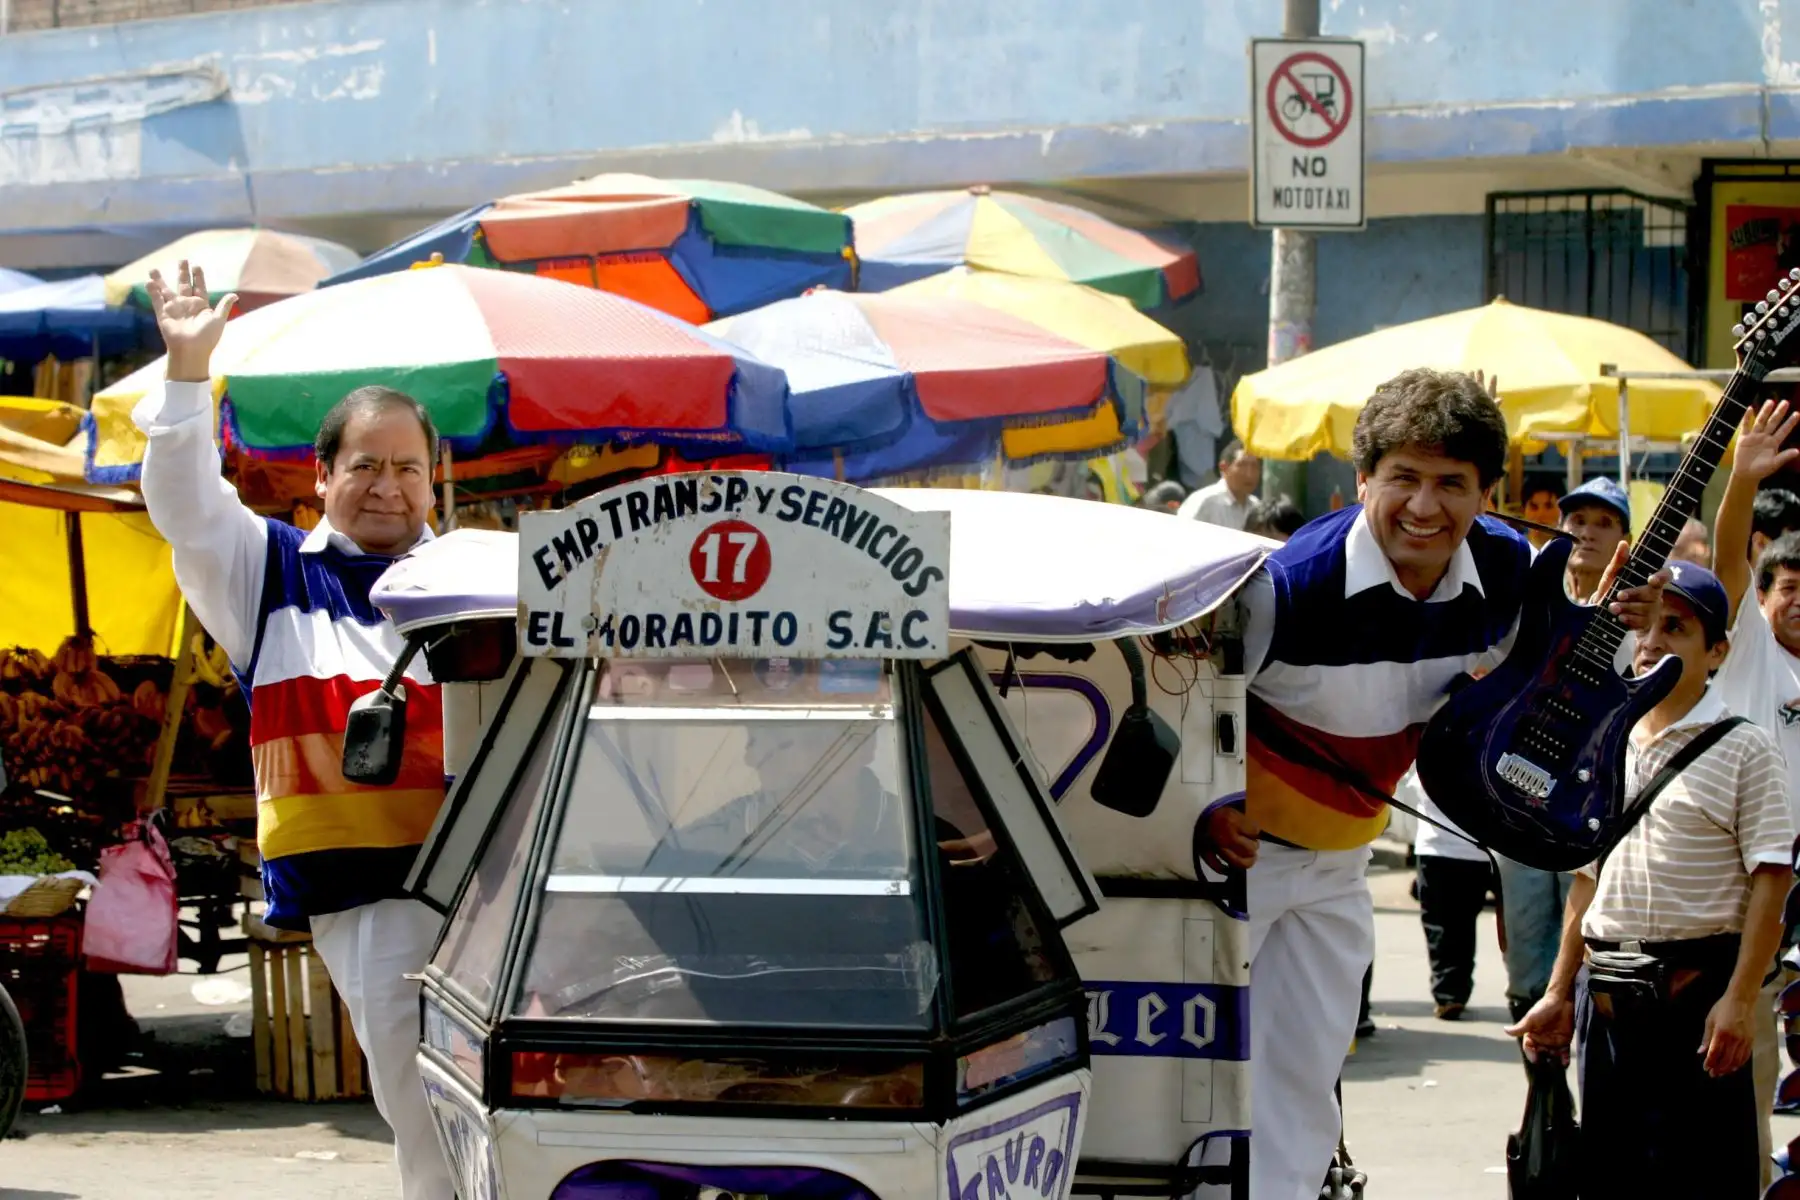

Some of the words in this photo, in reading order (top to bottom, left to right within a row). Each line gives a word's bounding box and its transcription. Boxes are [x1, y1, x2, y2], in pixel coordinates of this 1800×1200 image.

[1292, 156, 1327, 178] NO
[1272, 186, 1351, 210] MOTOTAXI
[532, 517, 604, 592] EMP.
[776, 484, 945, 598] SERVICIOS
[698, 531, 760, 584] 17
[526, 610, 575, 648] EL
[825, 609, 937, 650] S.A.C.
[1084, 989, 1217, 1050] Leo
